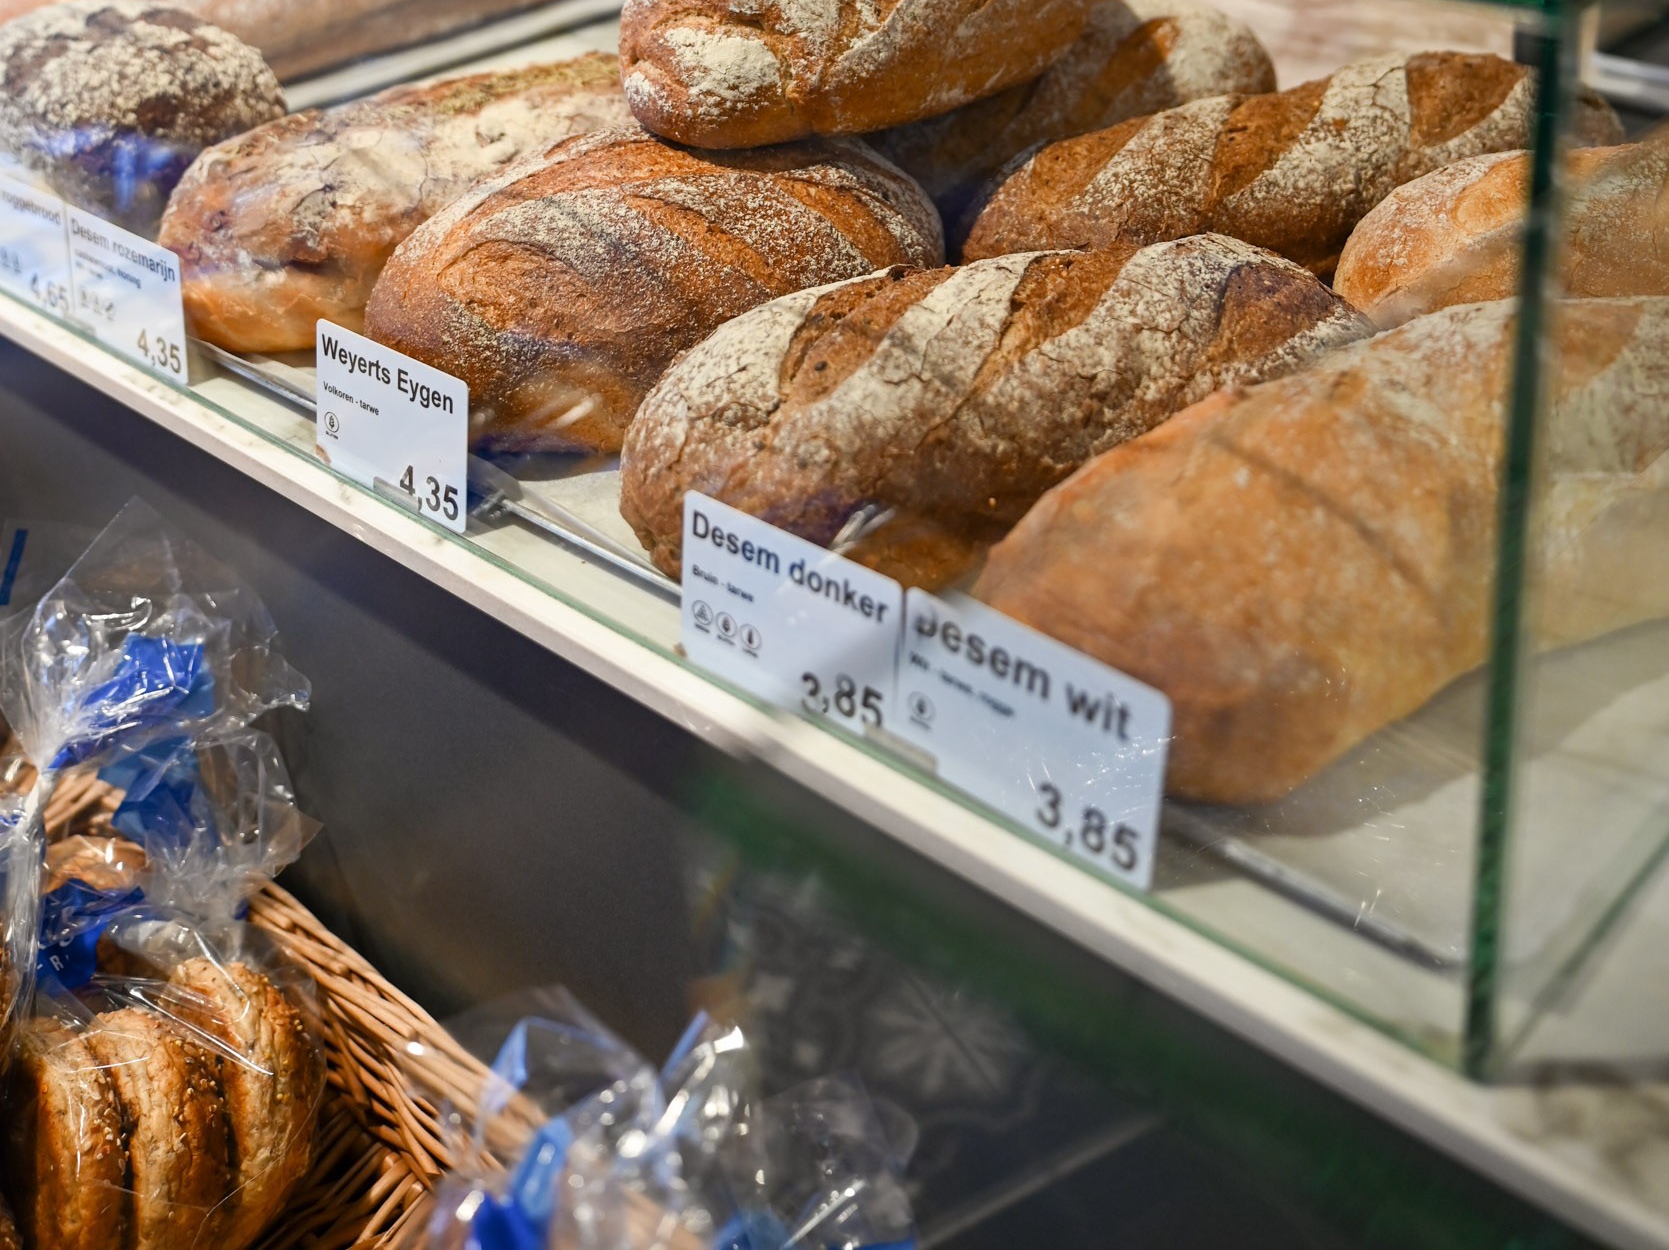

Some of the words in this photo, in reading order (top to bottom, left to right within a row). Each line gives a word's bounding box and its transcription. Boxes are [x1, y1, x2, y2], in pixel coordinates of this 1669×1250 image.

[71, 217, 110, 249] Desem
[112, 240, 176, 282] rozemarijn
[137, 327, 182, 374] 4,35
[322, 333, 391, 385] Weyerts
[397, 367, 454, 414] Eygen
[323, 381, 355, 404] Volkoren
[359, 399, 380, 416] tarwe
[399, 464, 459, 521] 4,35
[692, 509, 781, 574] Desem
[787, 557, 890, 624] donker
[1065, 681, 1132, 742] wit
[1036, 781, 1141, 873] 3,85
